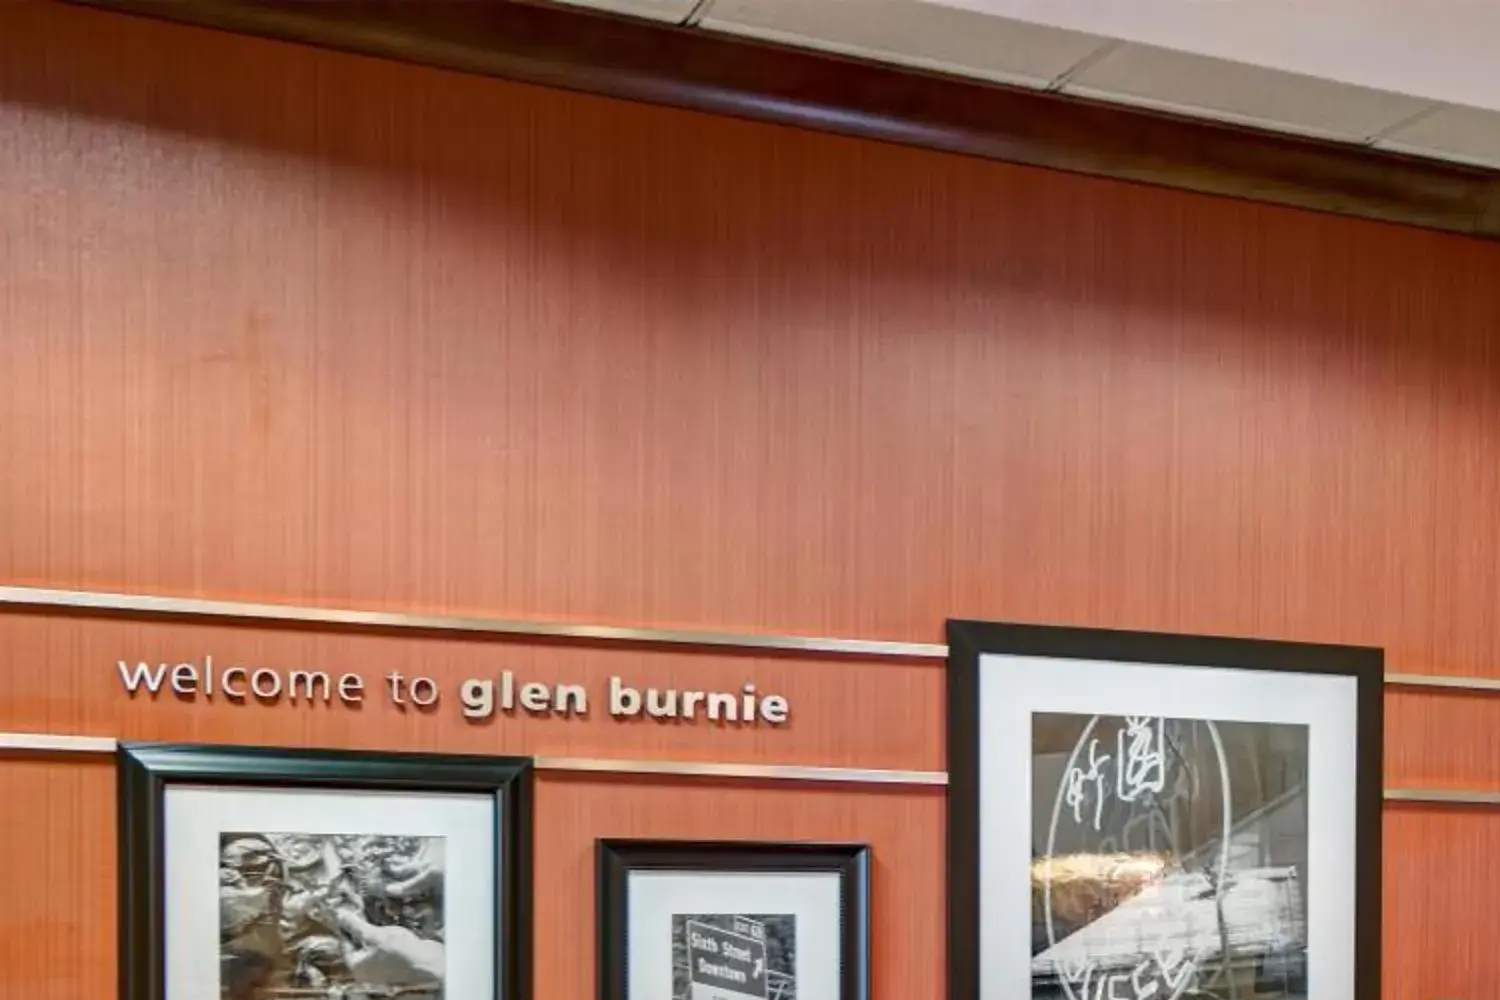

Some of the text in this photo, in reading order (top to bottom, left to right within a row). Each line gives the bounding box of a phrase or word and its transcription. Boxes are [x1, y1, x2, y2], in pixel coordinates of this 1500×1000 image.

[117, 655, 791, 723] welcome to glen burnie
